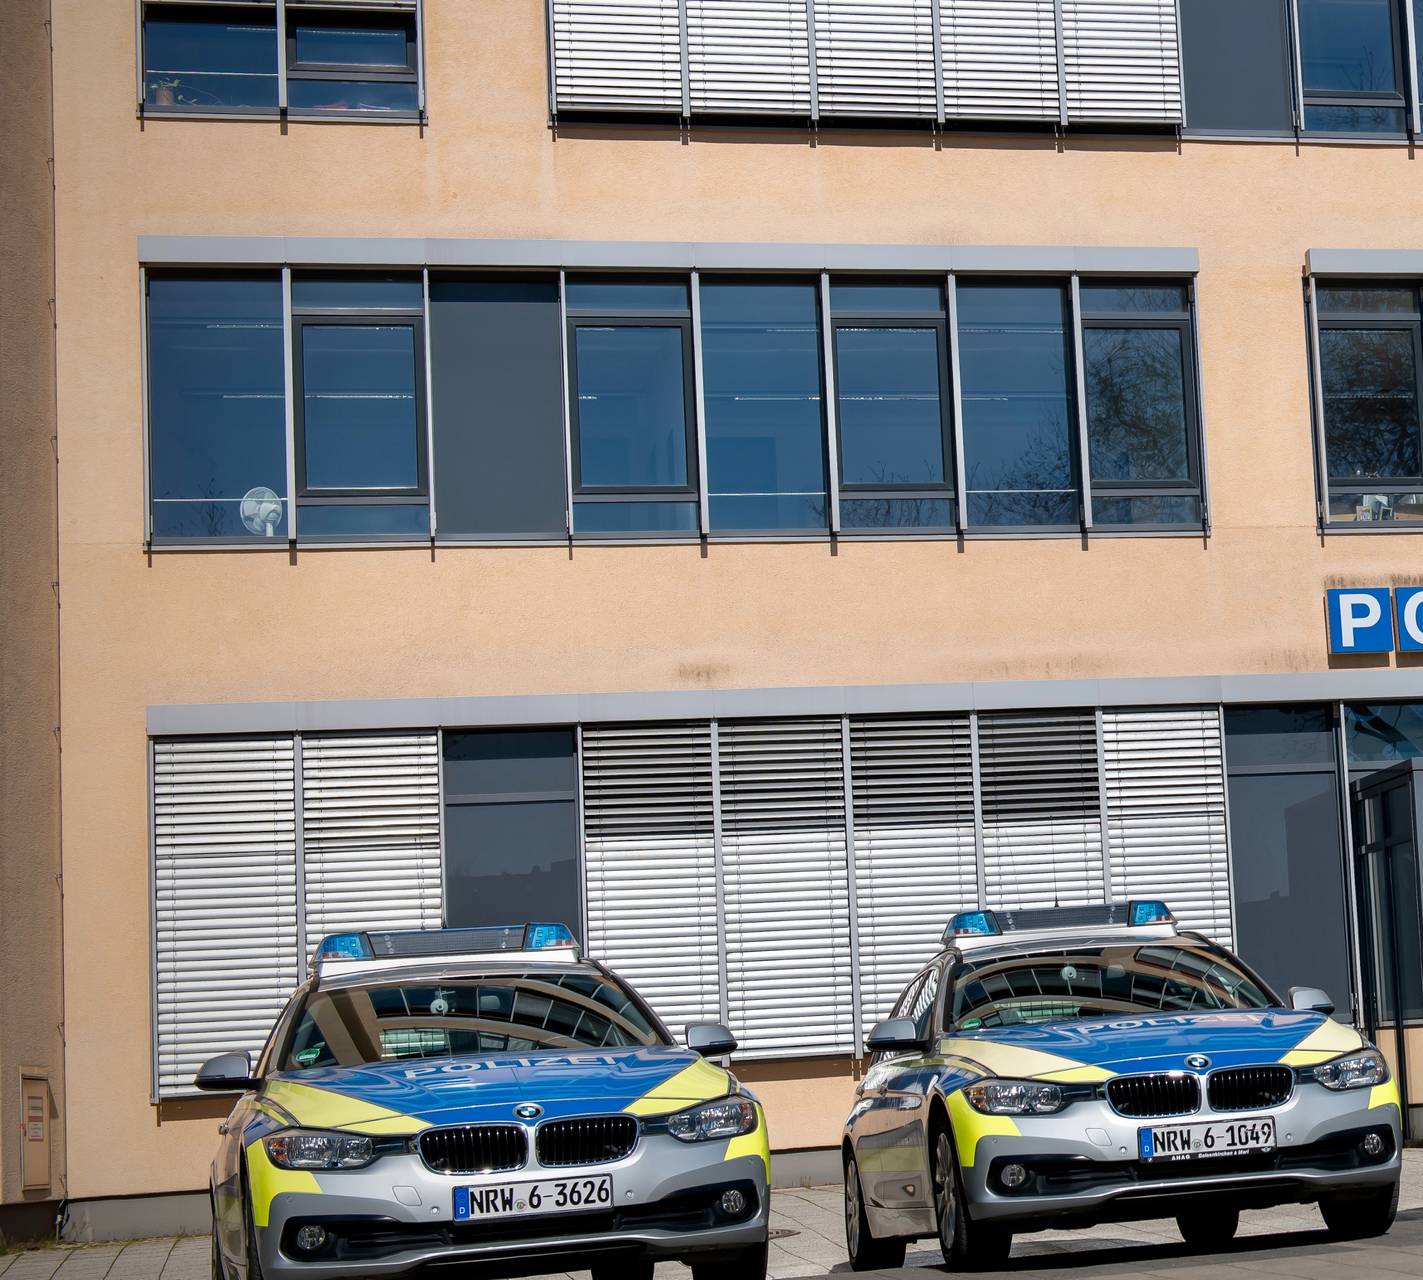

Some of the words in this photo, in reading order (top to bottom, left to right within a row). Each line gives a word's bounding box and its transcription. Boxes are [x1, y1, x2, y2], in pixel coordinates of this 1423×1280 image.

[405, 1056, 617, 1079] POLIZEI
[1153, 1129, 1191, 1153] NRW
[1204, 1123, 1272, 1149] 6-1049
[459, 1206, 466, 1214] D
[470, 1188, 514, 1214] NRW
[528, 1179, 610, 1209] 6-3626
